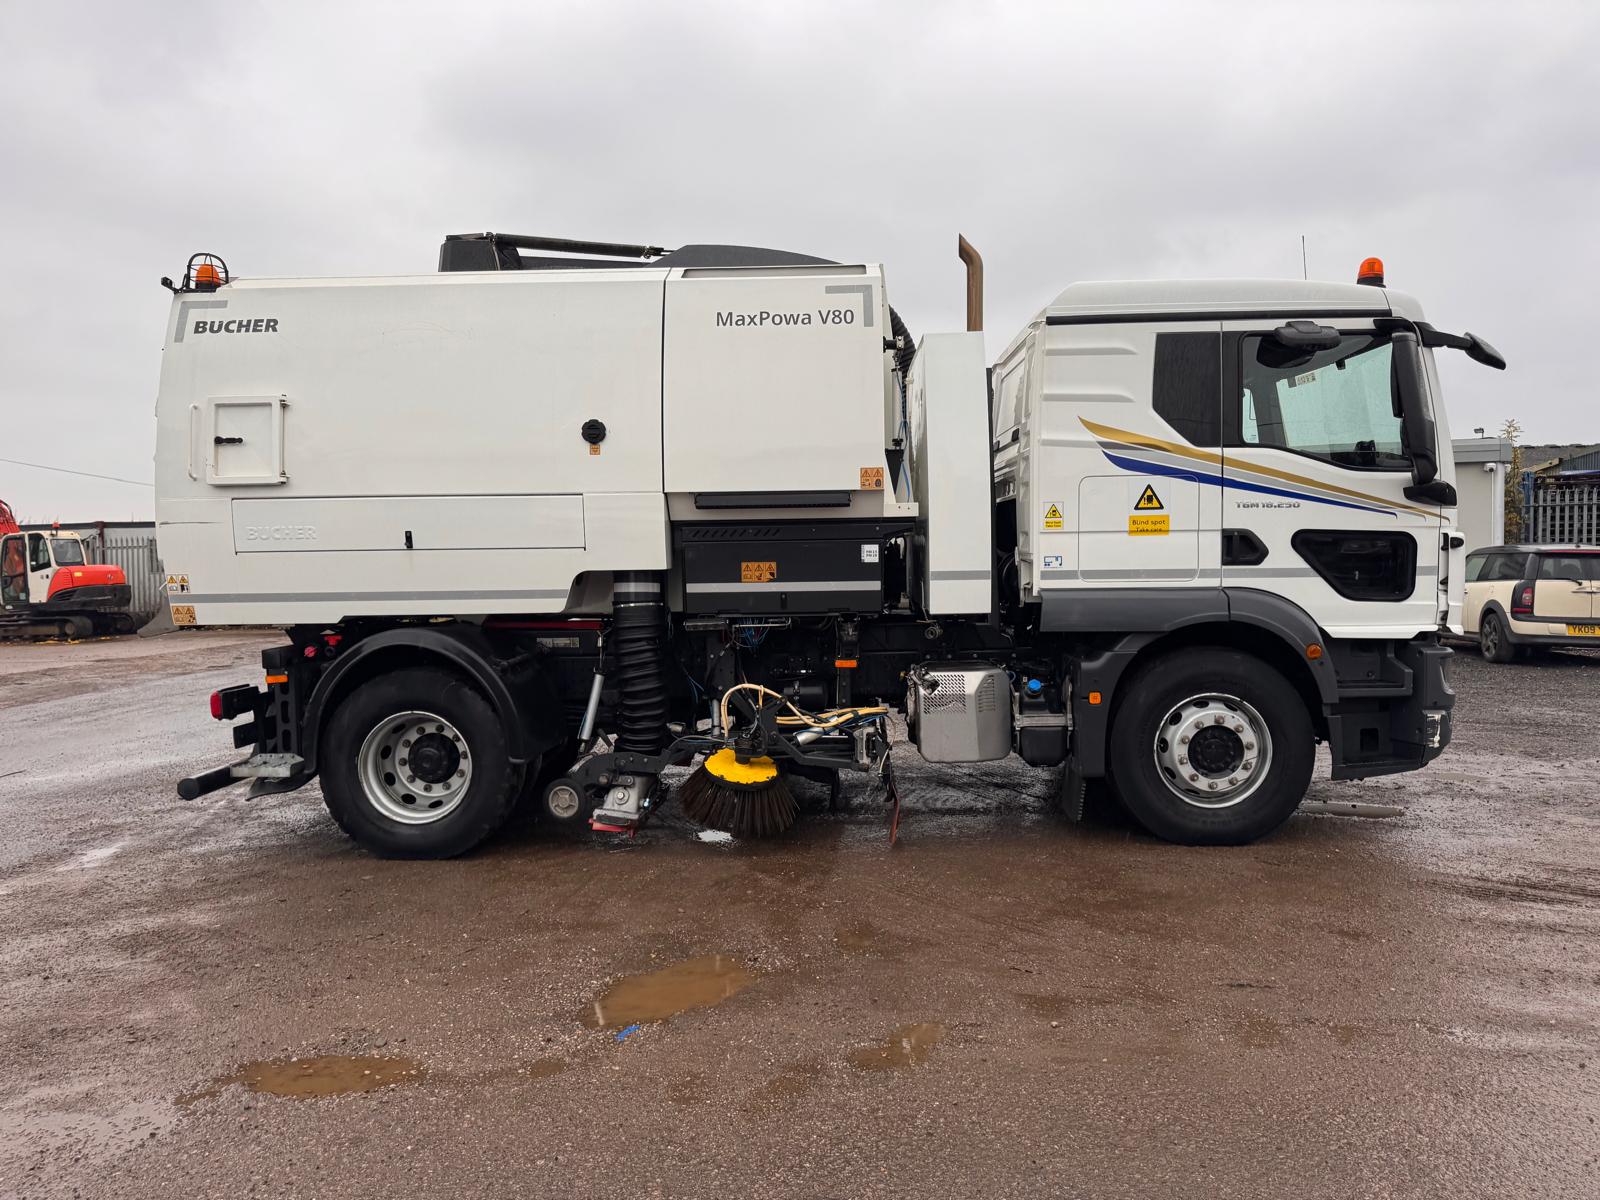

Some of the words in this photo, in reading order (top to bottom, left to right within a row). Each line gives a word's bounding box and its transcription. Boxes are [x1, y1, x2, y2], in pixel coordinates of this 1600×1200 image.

[716, 310, 812, 327] MaxPowa
[818, 309, 855, 325] V80
[193, 318, 279, 334] BUCHER
[245, 525, 317, 540] BUCHER
[1572, 624, 1596, 634] YK09
